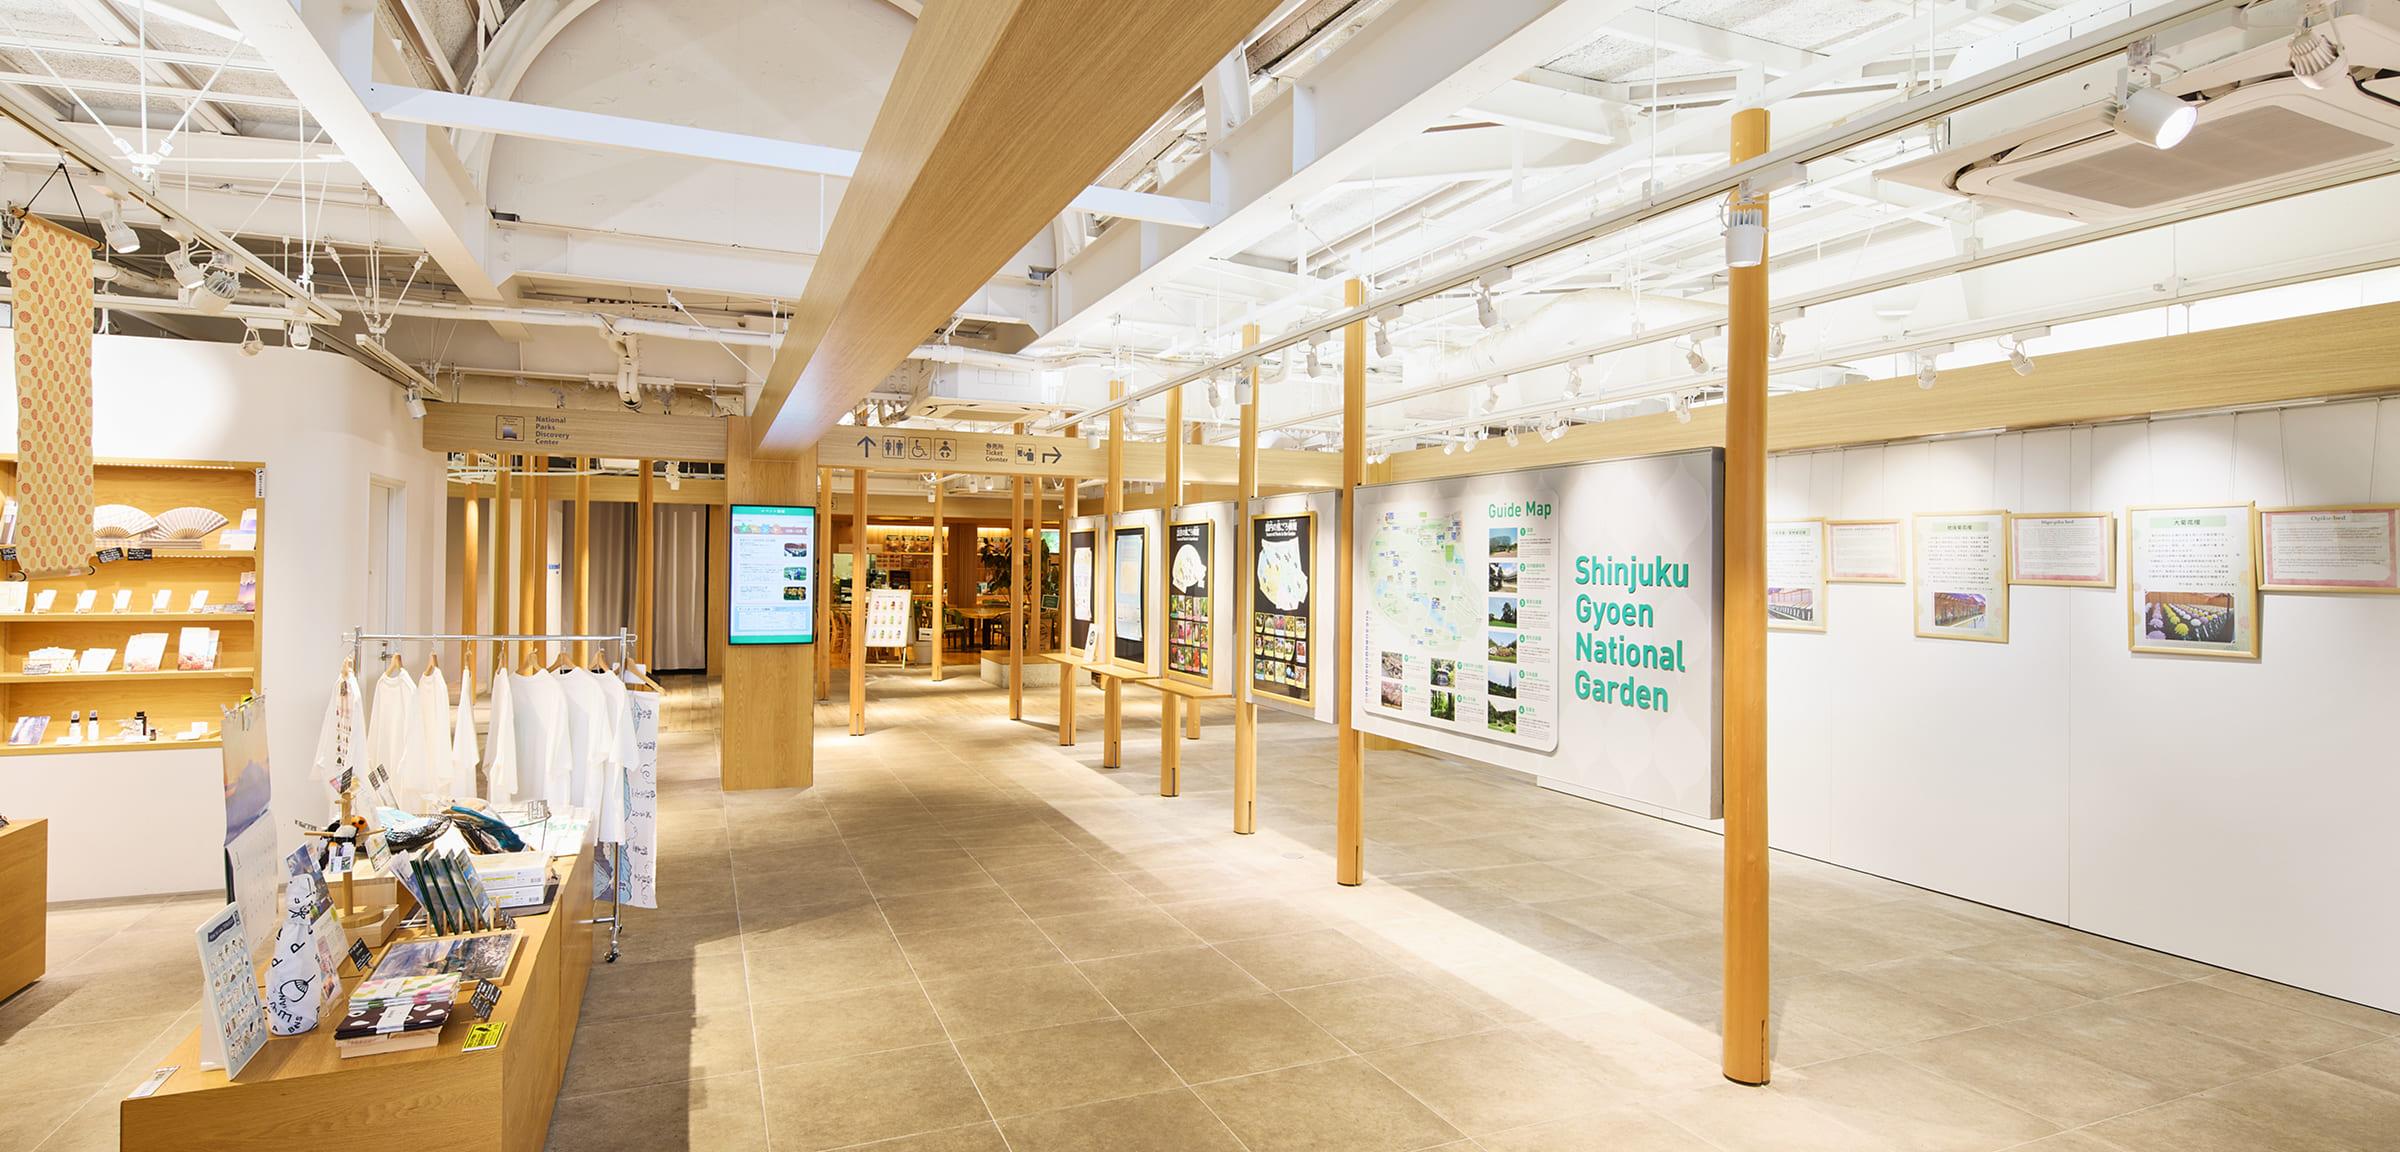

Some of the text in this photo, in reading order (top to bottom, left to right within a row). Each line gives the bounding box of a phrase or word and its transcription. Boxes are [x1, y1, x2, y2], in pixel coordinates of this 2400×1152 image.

[536, 431, 570, 440] Discovery
[1488, 501, 1552, 520] Guide Map
[1575, 554, 1689, 594] Shinjuku
[1576, 594, 1654, 630] Gyoen
[1576, 632, 1686, 672] National
[1576, 670, 1668, 712] Garden
